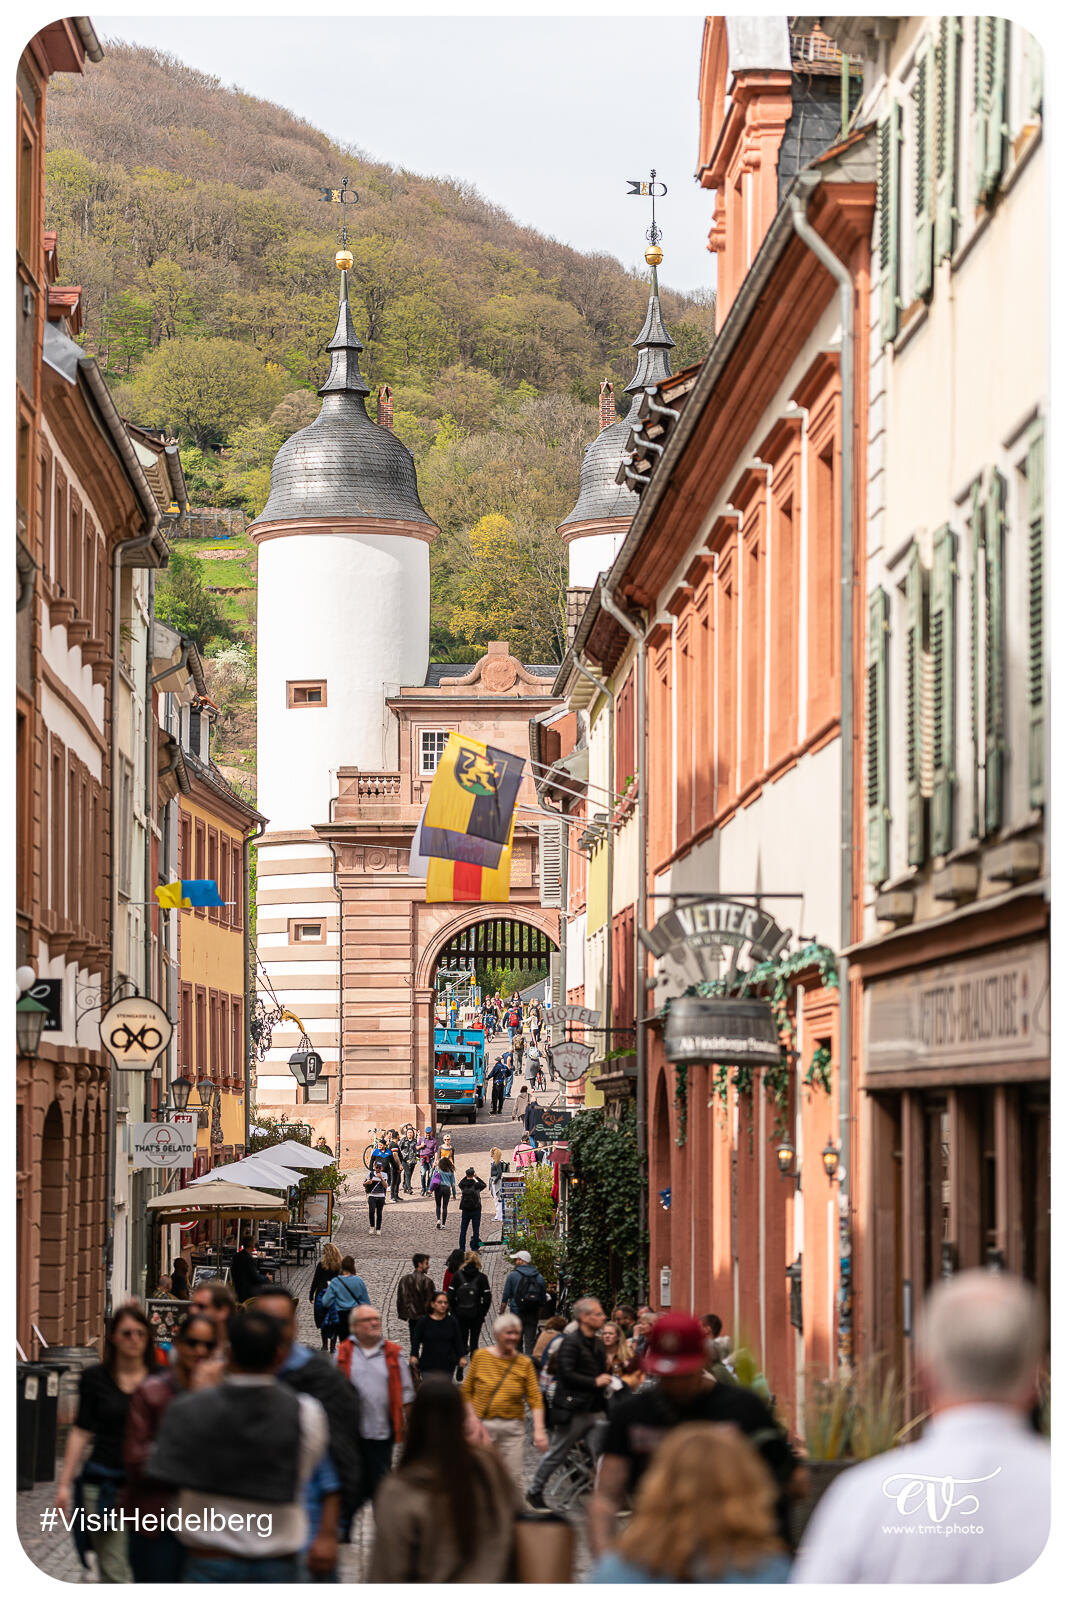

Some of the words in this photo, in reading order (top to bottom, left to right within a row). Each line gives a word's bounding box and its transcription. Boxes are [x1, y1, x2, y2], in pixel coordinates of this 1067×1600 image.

[675, 902, 759, 939] VETTER
[545, 1006, 597, 1025] HOTEL
[135, 1144, 160, 1152] THAT'S
[162, 1144, 192, 1153] GELATO
